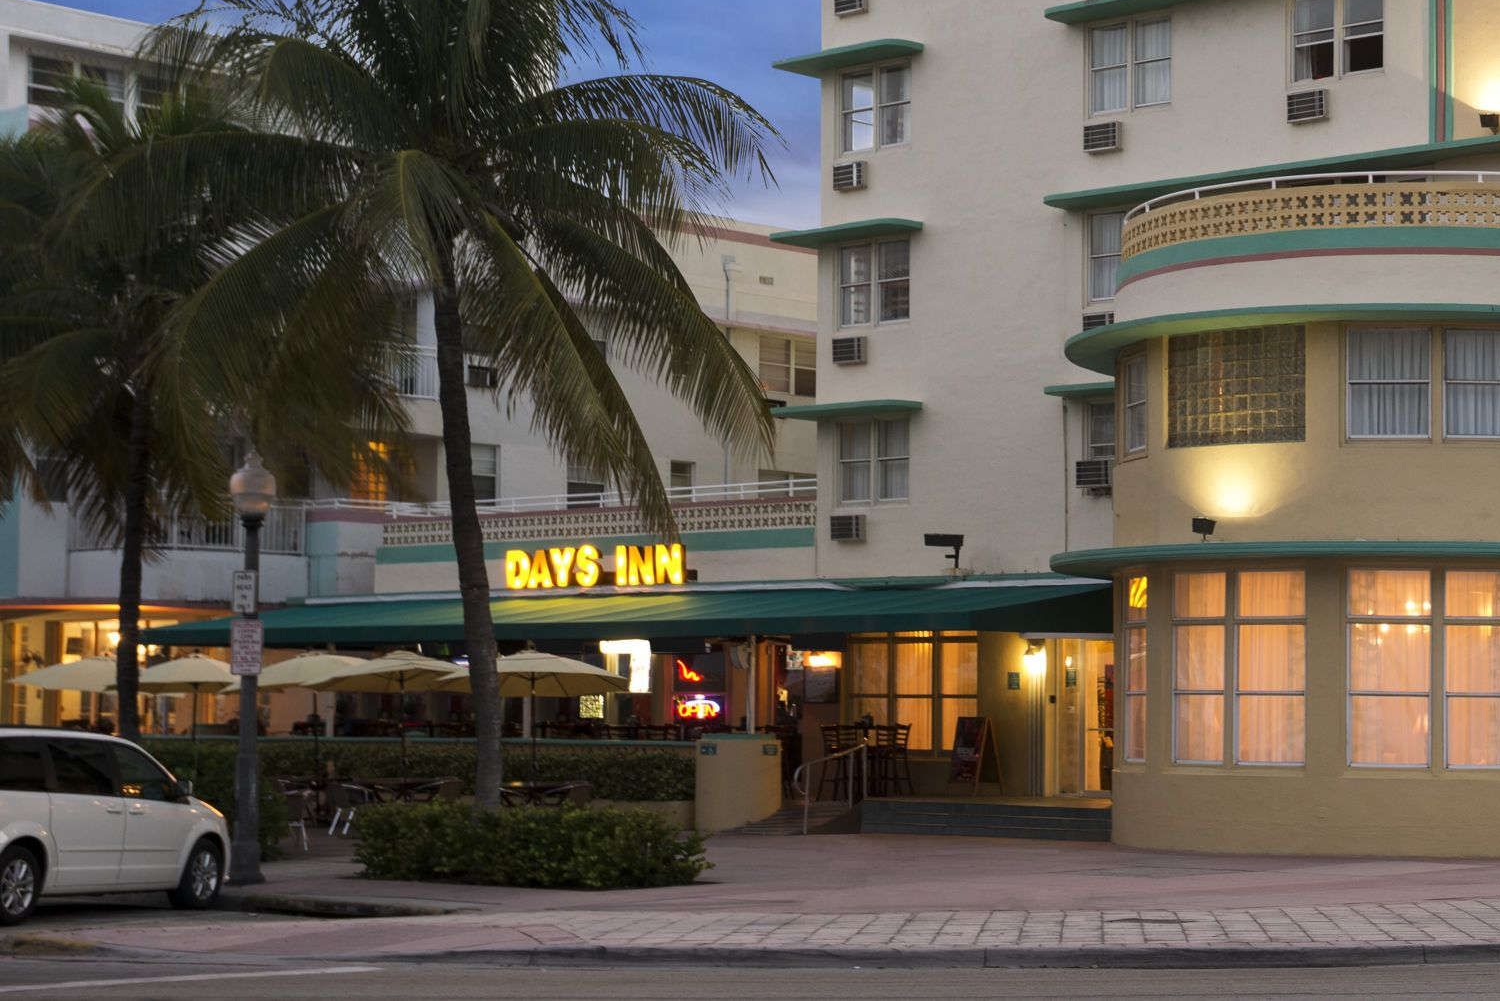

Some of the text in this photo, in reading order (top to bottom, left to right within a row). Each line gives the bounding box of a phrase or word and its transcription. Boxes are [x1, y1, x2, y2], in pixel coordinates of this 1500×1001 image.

[505, 543, 683, 589] DAYS INN
[677, 702, 717, 718] OPEN
